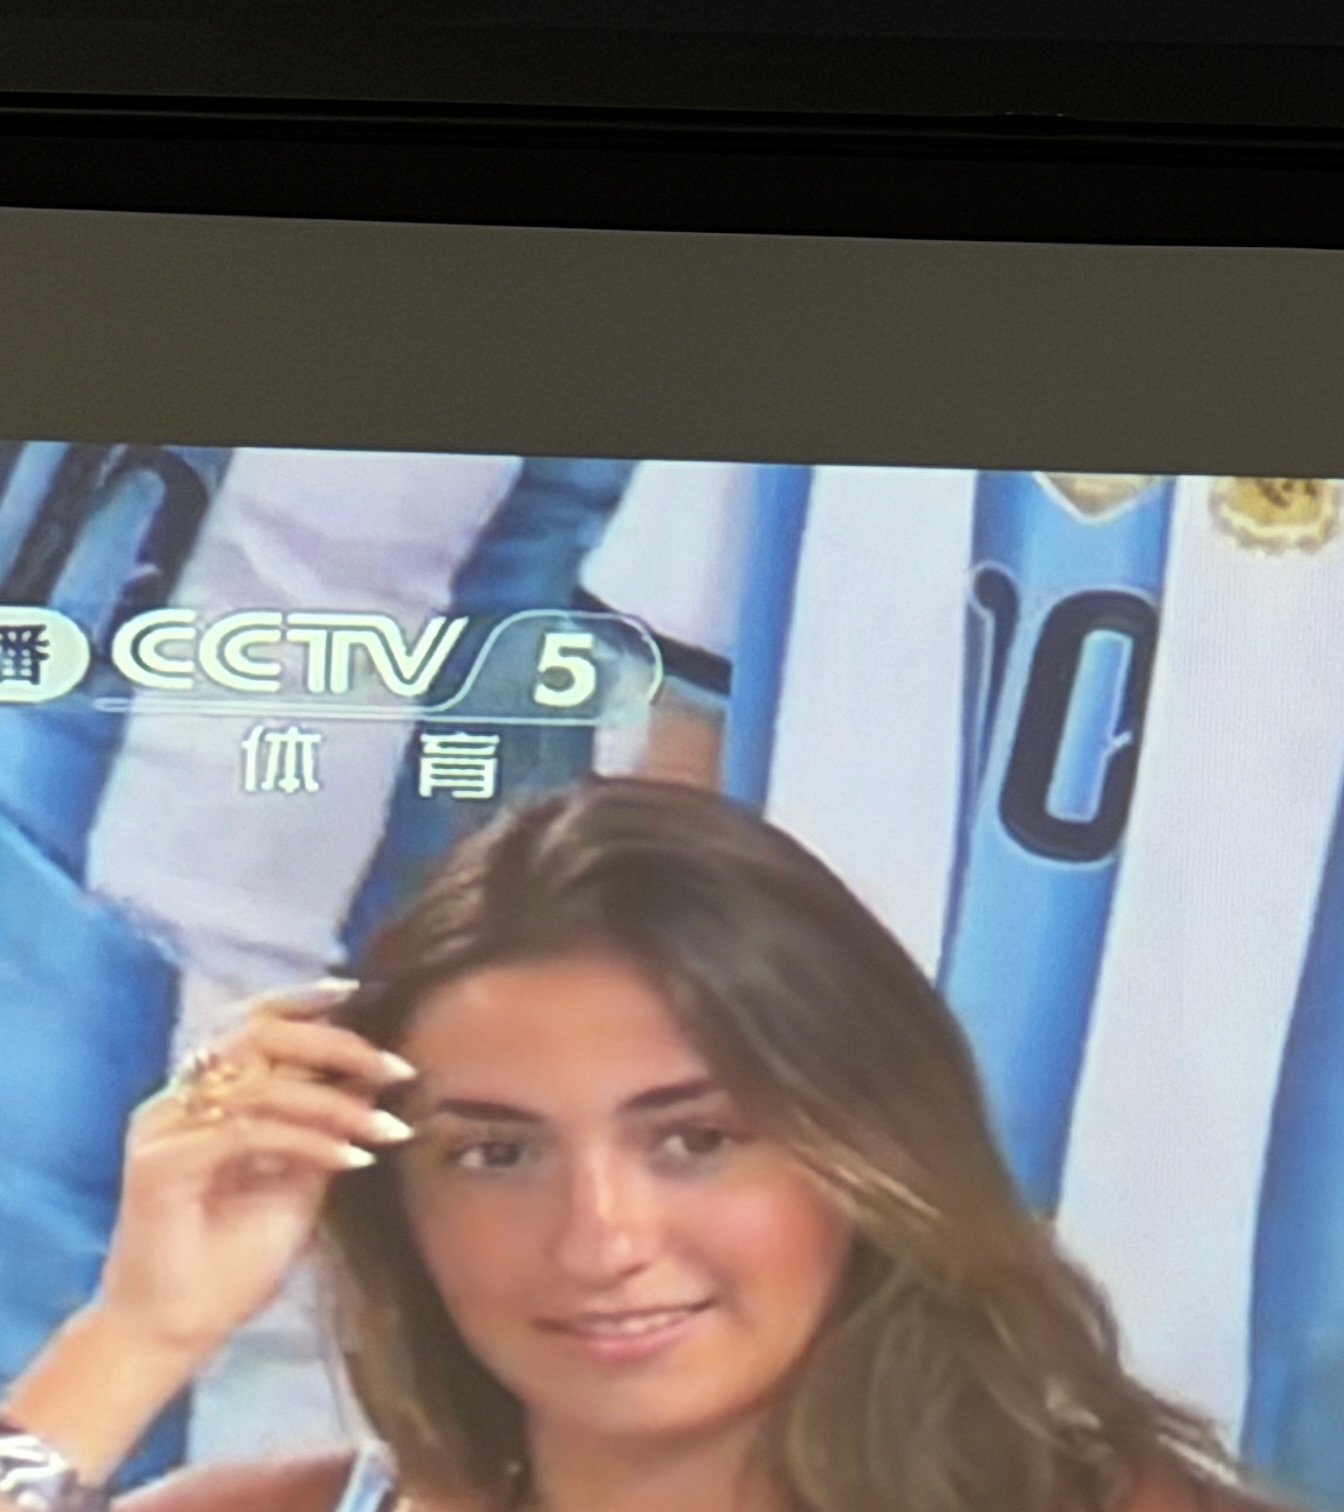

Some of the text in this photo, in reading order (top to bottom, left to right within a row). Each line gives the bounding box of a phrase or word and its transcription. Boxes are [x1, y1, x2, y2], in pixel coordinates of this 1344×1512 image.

[111, 608, 598, 708] CCTV 5
[241, 724, 501, 799] 体育
